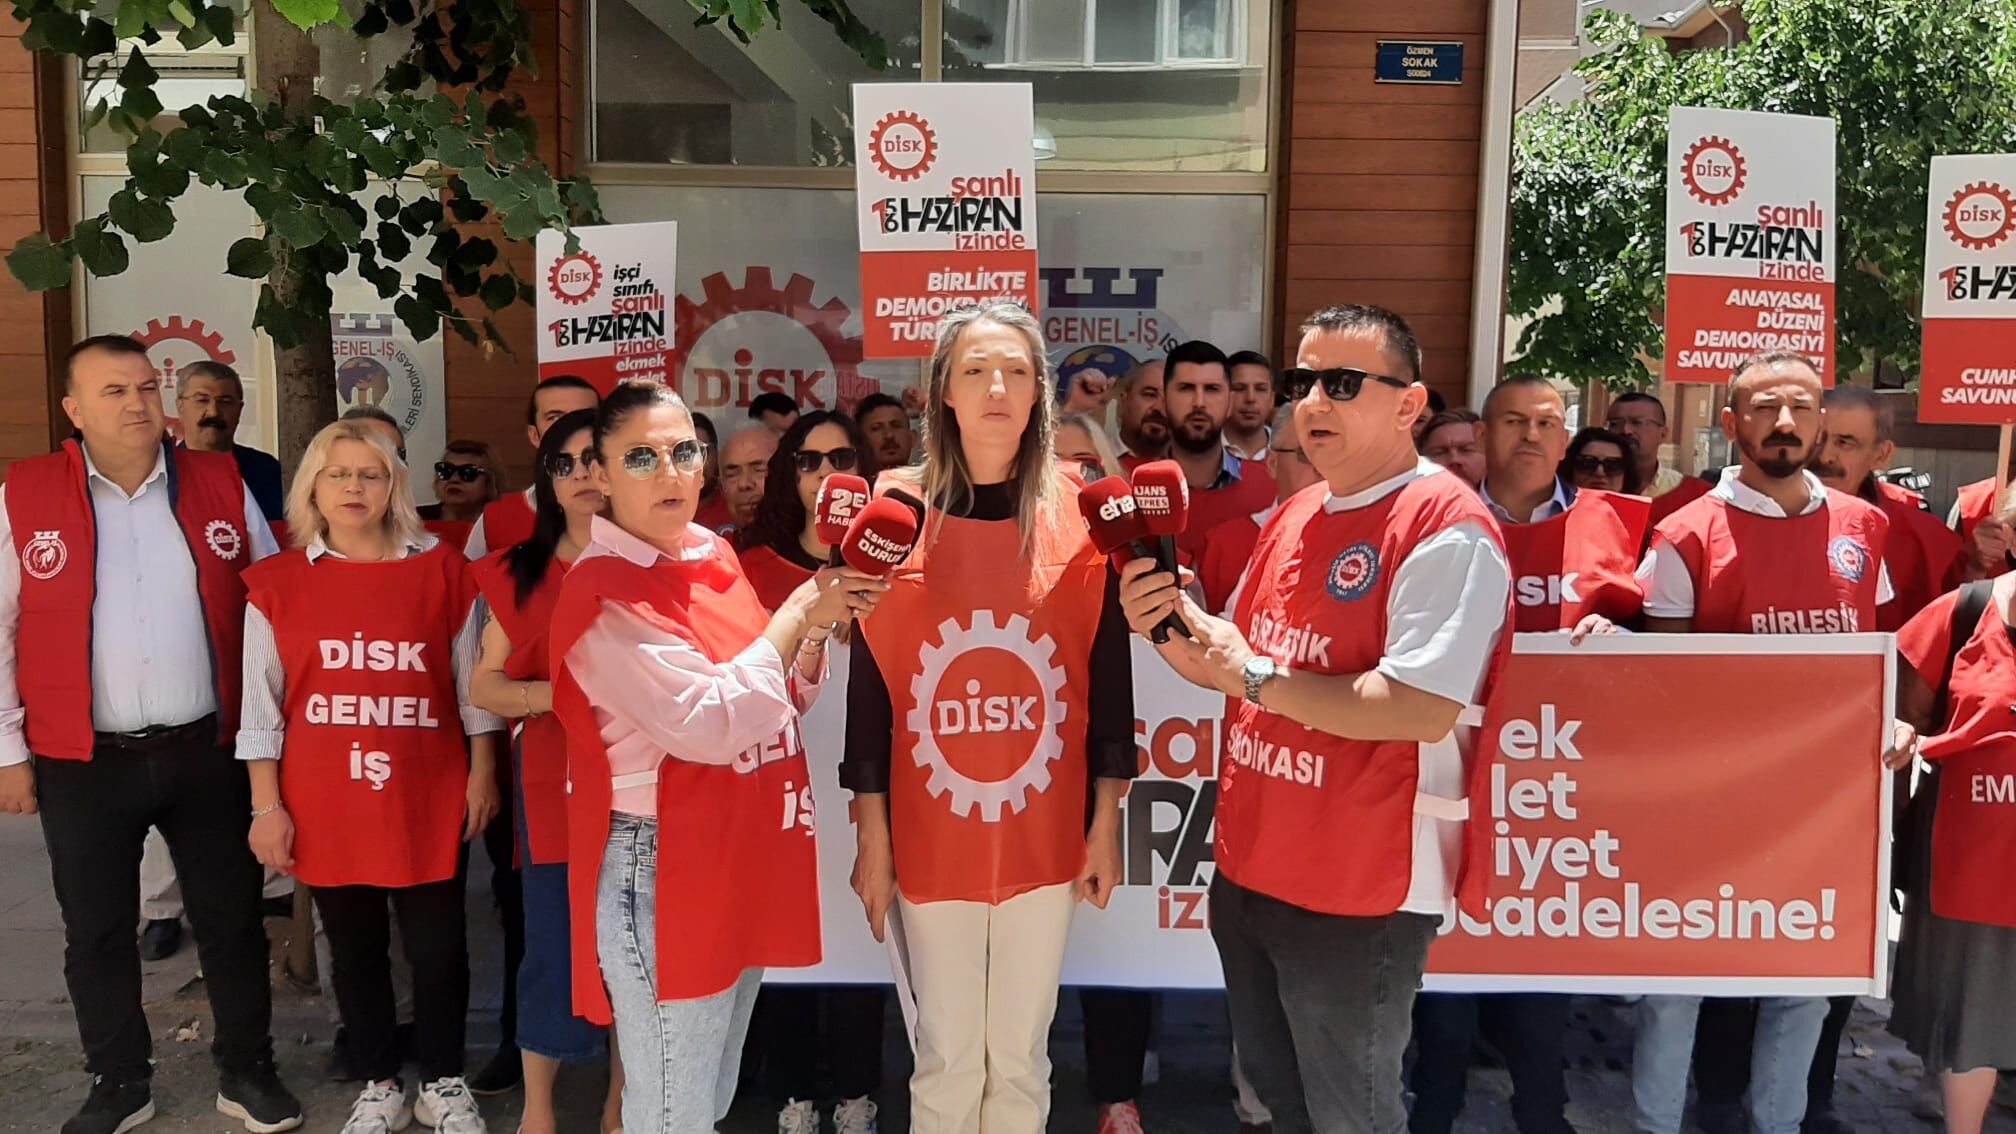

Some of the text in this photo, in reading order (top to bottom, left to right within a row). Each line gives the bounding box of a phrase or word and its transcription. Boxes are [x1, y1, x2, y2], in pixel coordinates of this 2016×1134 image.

[1401, 57, 1438, 67] SOKAK
[885, 134, 922, 152] DİSK
[1696, 160, 1732, 178] DİSK
[951, 169, 1021, 204] şanlı
[1758, 200, 1822, 231] şanlı
[1959, 204, 2002, 222] DİSK
[955, 229, 1024, 250] izinde
[561, 268, 590, 284] DİSK
[614, 263, 641, 282] işçi
[927, 267, 1028, 292] BİRLİKTE
[1759, 260, 1824, 281] izinde
[612, 289, 664, 319] şanlı
[1726, 288, 1825, 310] ANAYASAL
[1046, 311, 1158, 350] GENEL-İŞ
[1757, 308, 1825, 332] DÜZENİ
[614, 336, 666, 356] izinde
[1694, 329, 1825, 352] DEMOKRASİYİ
[616, 353, 666, 372] ekmek
[694, 348, 826, 408] DİSK
[318, 632, 426, 672] DİSK
[306, 694, 439, 728] GENEL
[936, 678, 1038, 736] DİSK
[350, 742, 391, 790] İŞ
[1972, 774, 2016, 803] EM
